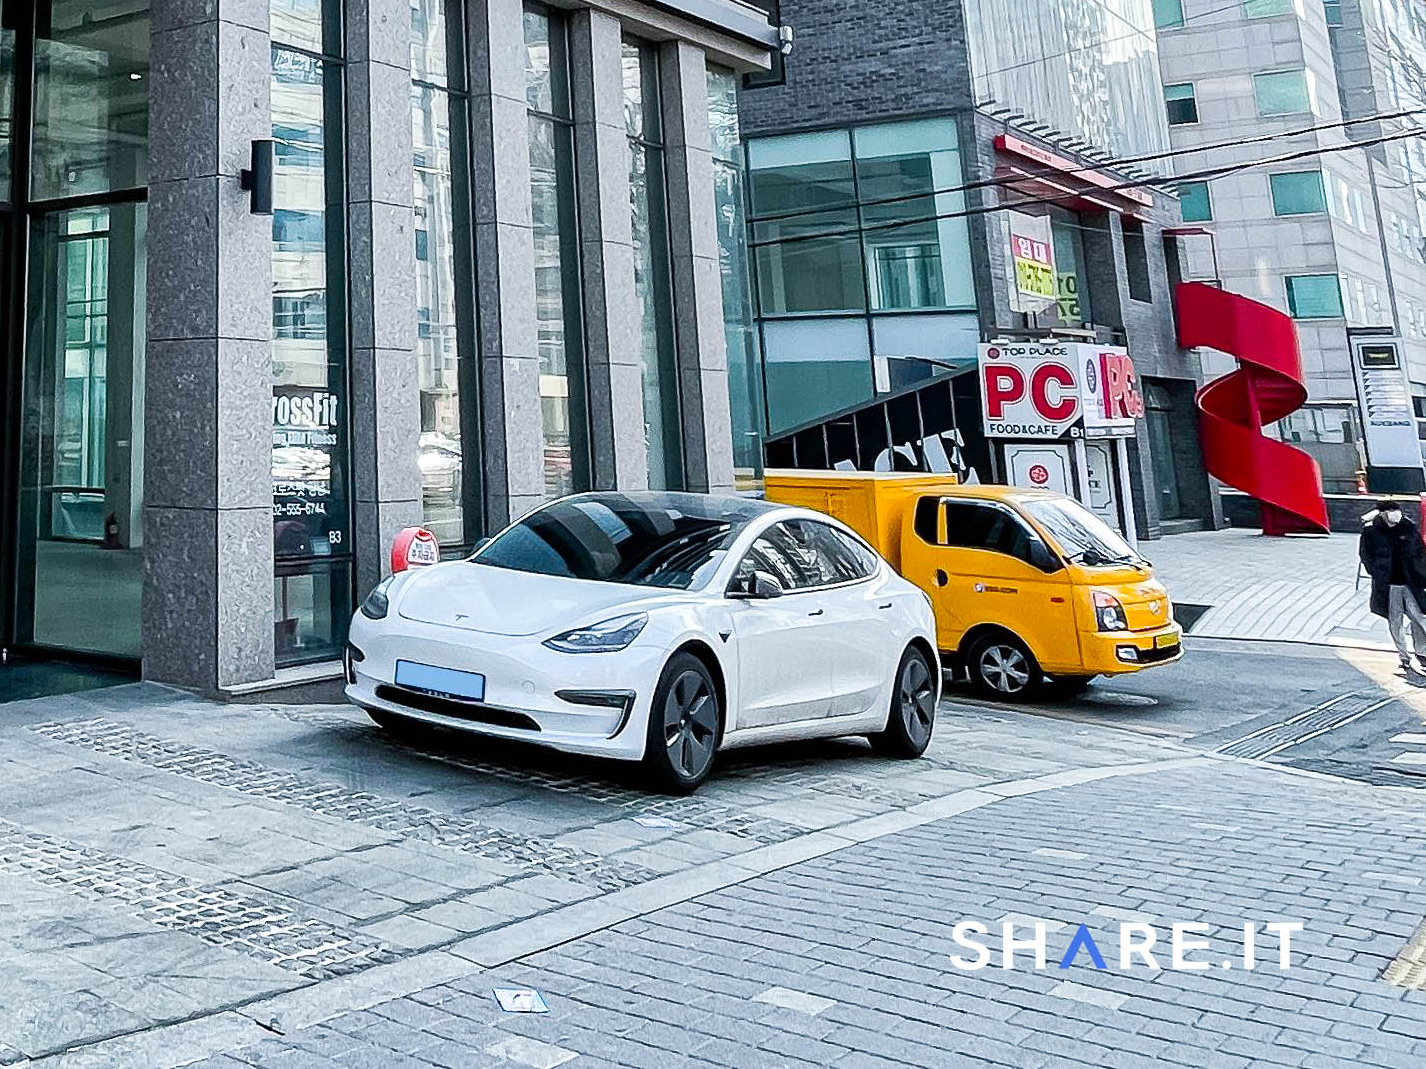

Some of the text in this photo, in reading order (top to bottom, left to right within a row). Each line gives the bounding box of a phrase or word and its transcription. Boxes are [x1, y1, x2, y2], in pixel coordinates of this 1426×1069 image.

[1002, 347, 1068, 357] TOP PLACE
[982, 361, 1080, 424] PC
[271, 391, 338, 427] rossFit
[989, 423, 1059, 436] FOOD&CAFE
[329, 530, 342, 544] B3
